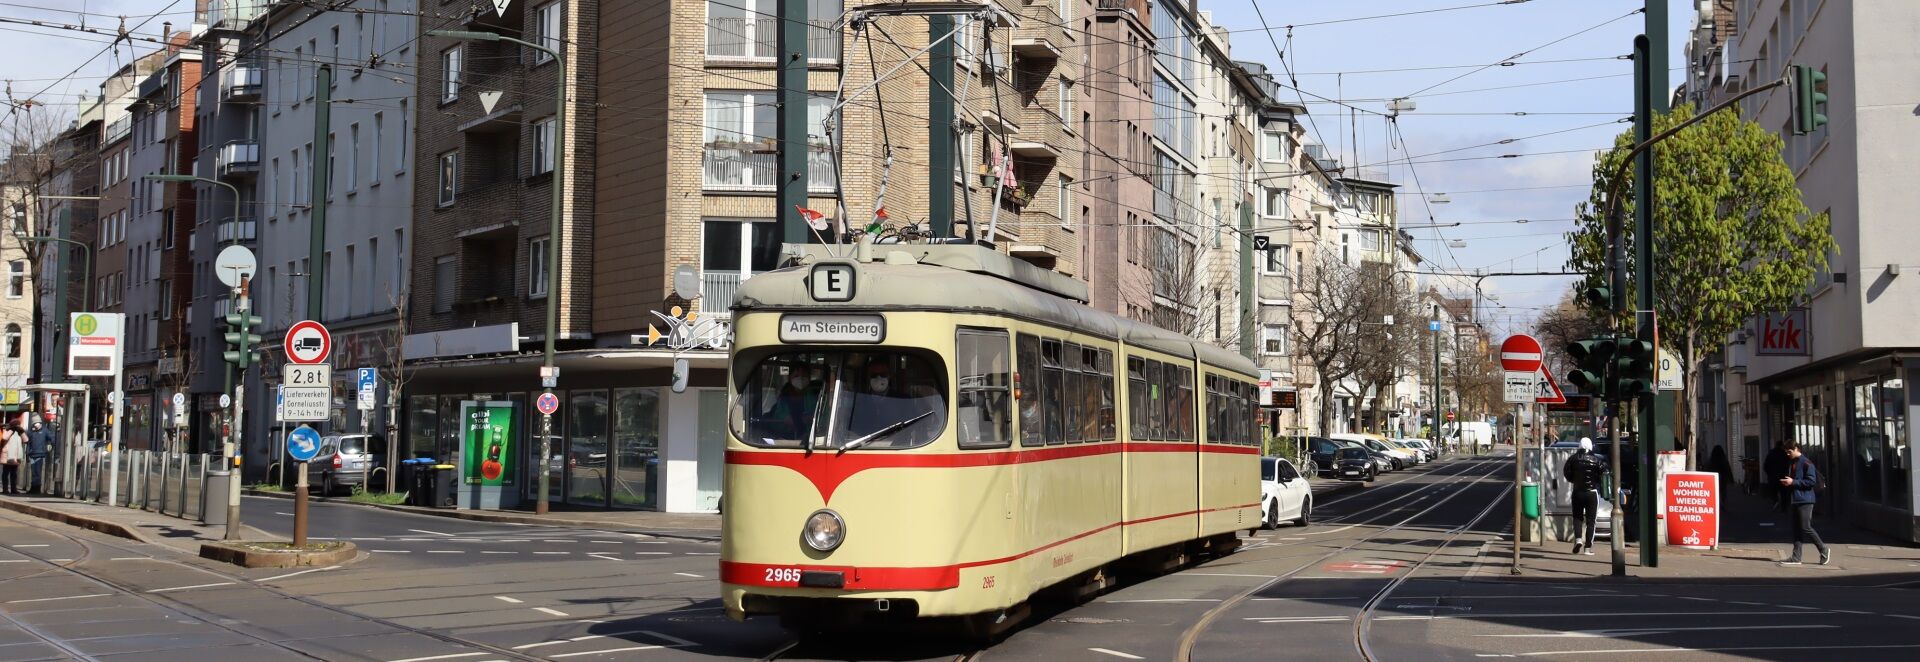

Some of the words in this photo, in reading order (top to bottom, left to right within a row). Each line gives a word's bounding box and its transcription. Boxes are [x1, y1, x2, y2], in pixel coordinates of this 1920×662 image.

[827, 270, 841, 292] E
[80, 318, 92, 332] H
[790, 321, 811, 333] Am
[815, 321, 878, 337] Steinberg
[1763, 314, 1801, 349] kik
[293, 369, 314, 384] 2,8
[317, 369, 322, 384] t
[361, 369, 368, 380] P
[286, 390, 327, 398] Lieferverkehr
[287, 409, 304, 417] 9-14
[306, 409, 311, 417] h
[313, 409, 325, 417] frei
[1673, 489, 1710, 497] WOHNEN
[1676, 497, 1707, 505] WIEDER
[1669, 505, 1714, 514] BEZAHLBAR
[1679, 514, 1703, 522] WIRD.
[1682, 536, 1700, 545] SPD
[765, 568, 801, 582] 2965
[982, 575, 995, 589] 2965
